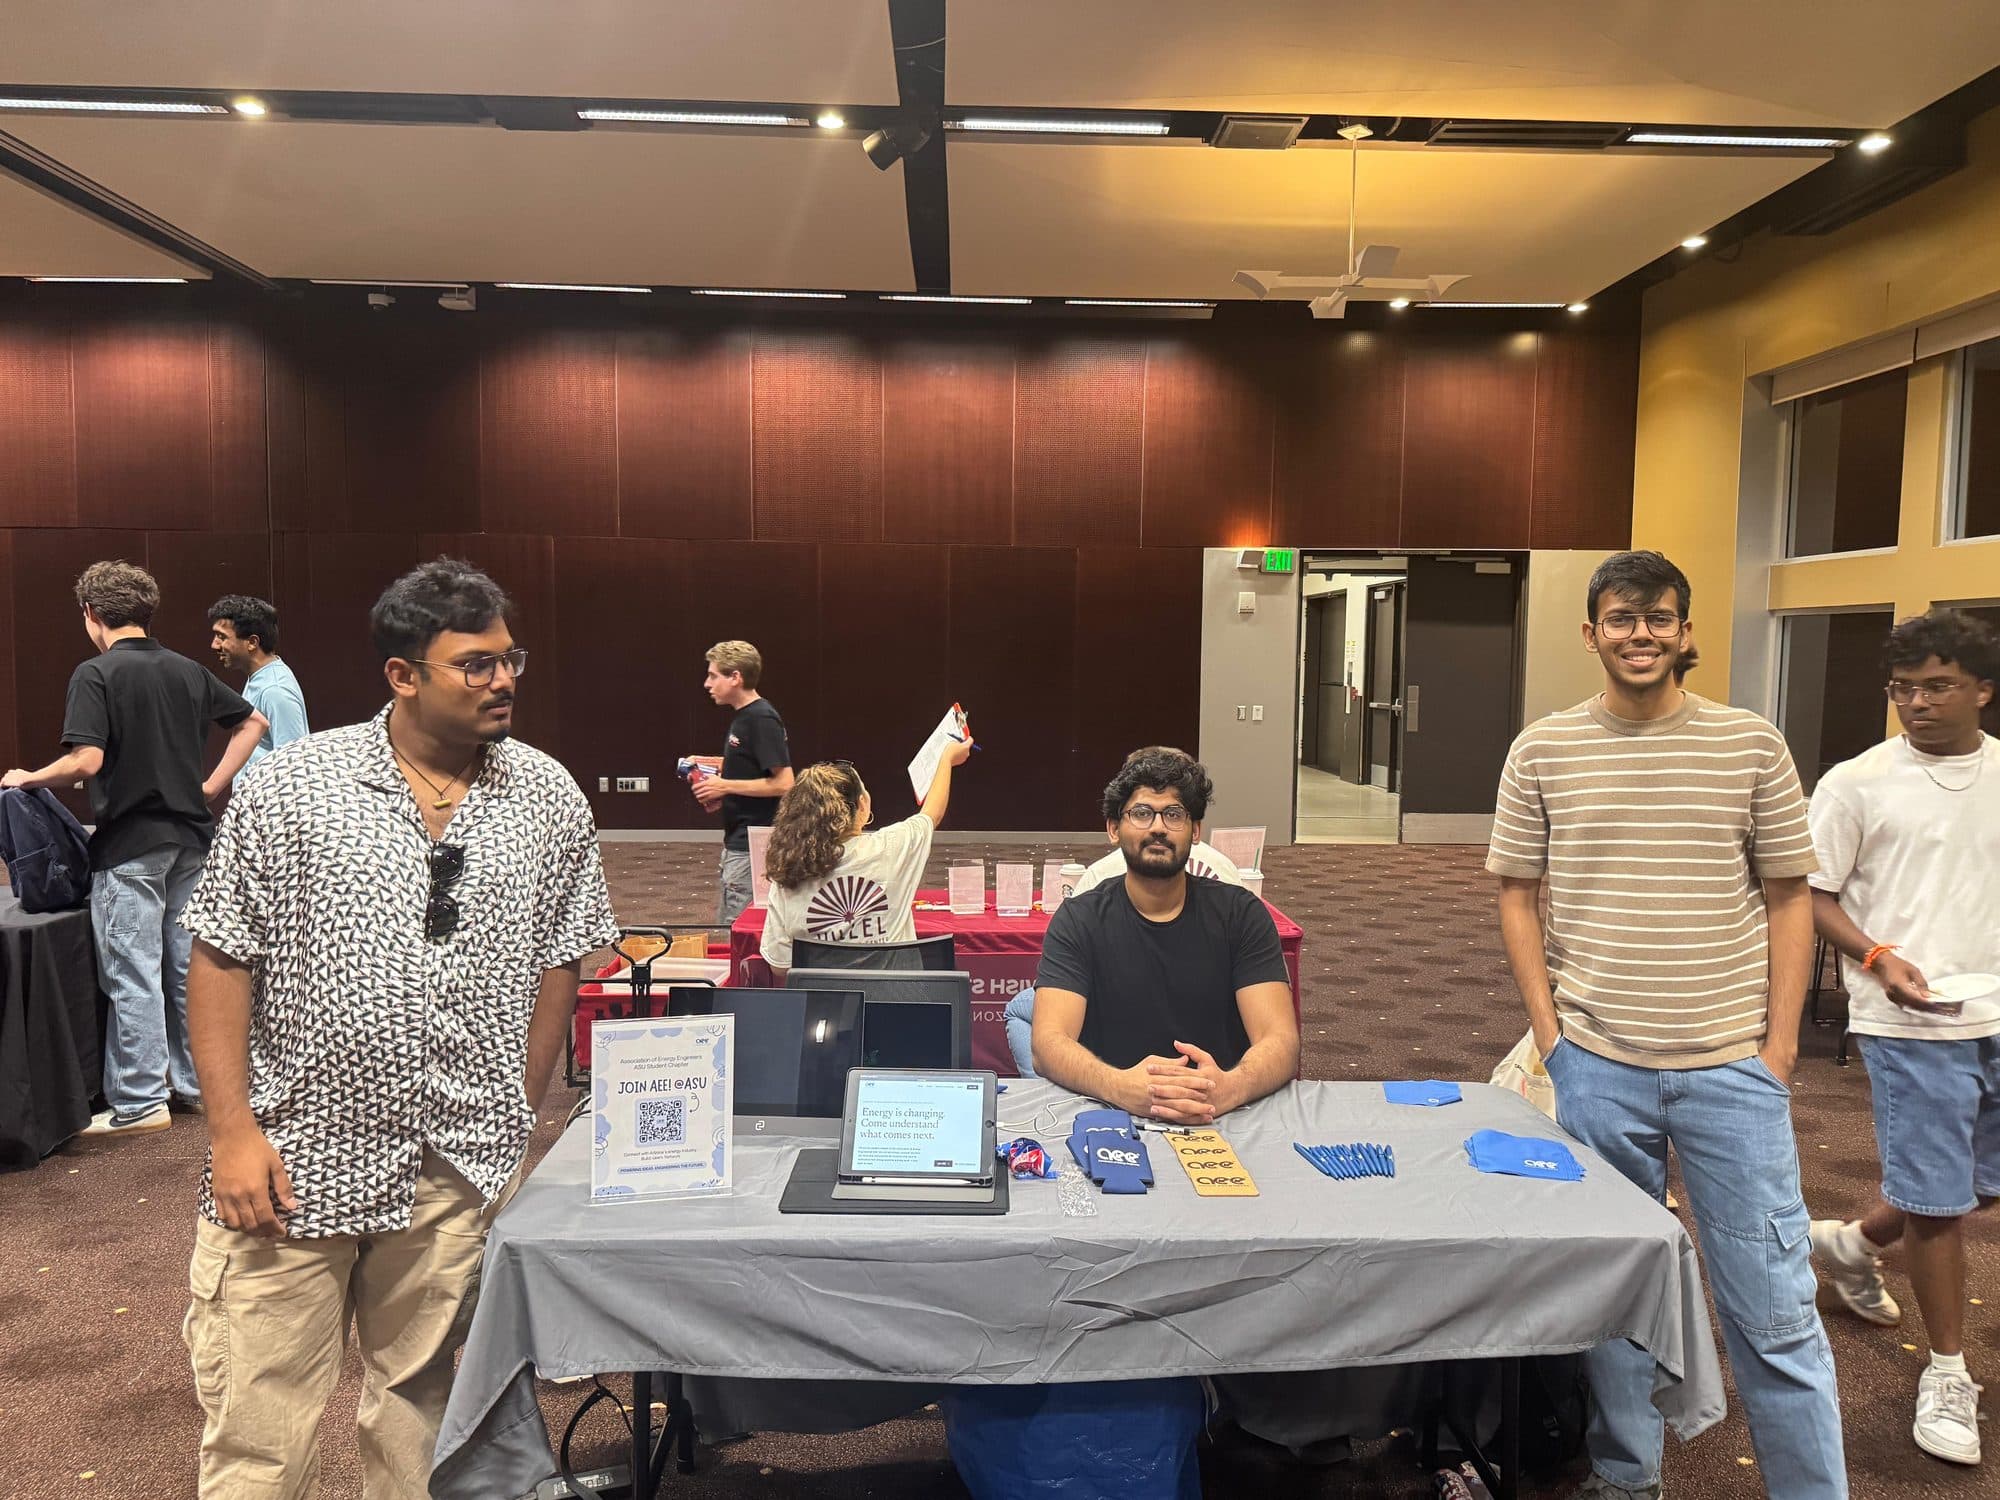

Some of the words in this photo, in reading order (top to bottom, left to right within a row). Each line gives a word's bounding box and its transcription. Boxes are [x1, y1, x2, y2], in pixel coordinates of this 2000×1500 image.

[1266, 550, 1293, 571] EXIT
[618, 1081, 647, 1095] JOIN
[649, 1079, 672, 1093] AEE!
[674, 1077, 707, 1090] @ASU
[862, 1107, 894, 1120] Energy
[895, 1108, 903, 1117] is
[903, 1108, 945, 1120] changing.
[860, 1118, 888, 1129] Come
[889, 1119, 939, 1129] understand
[859, 1130, 883, 1139] what
[883, 1132, 912, 1140] comes
[913, 1132, 935, 1140] next.
